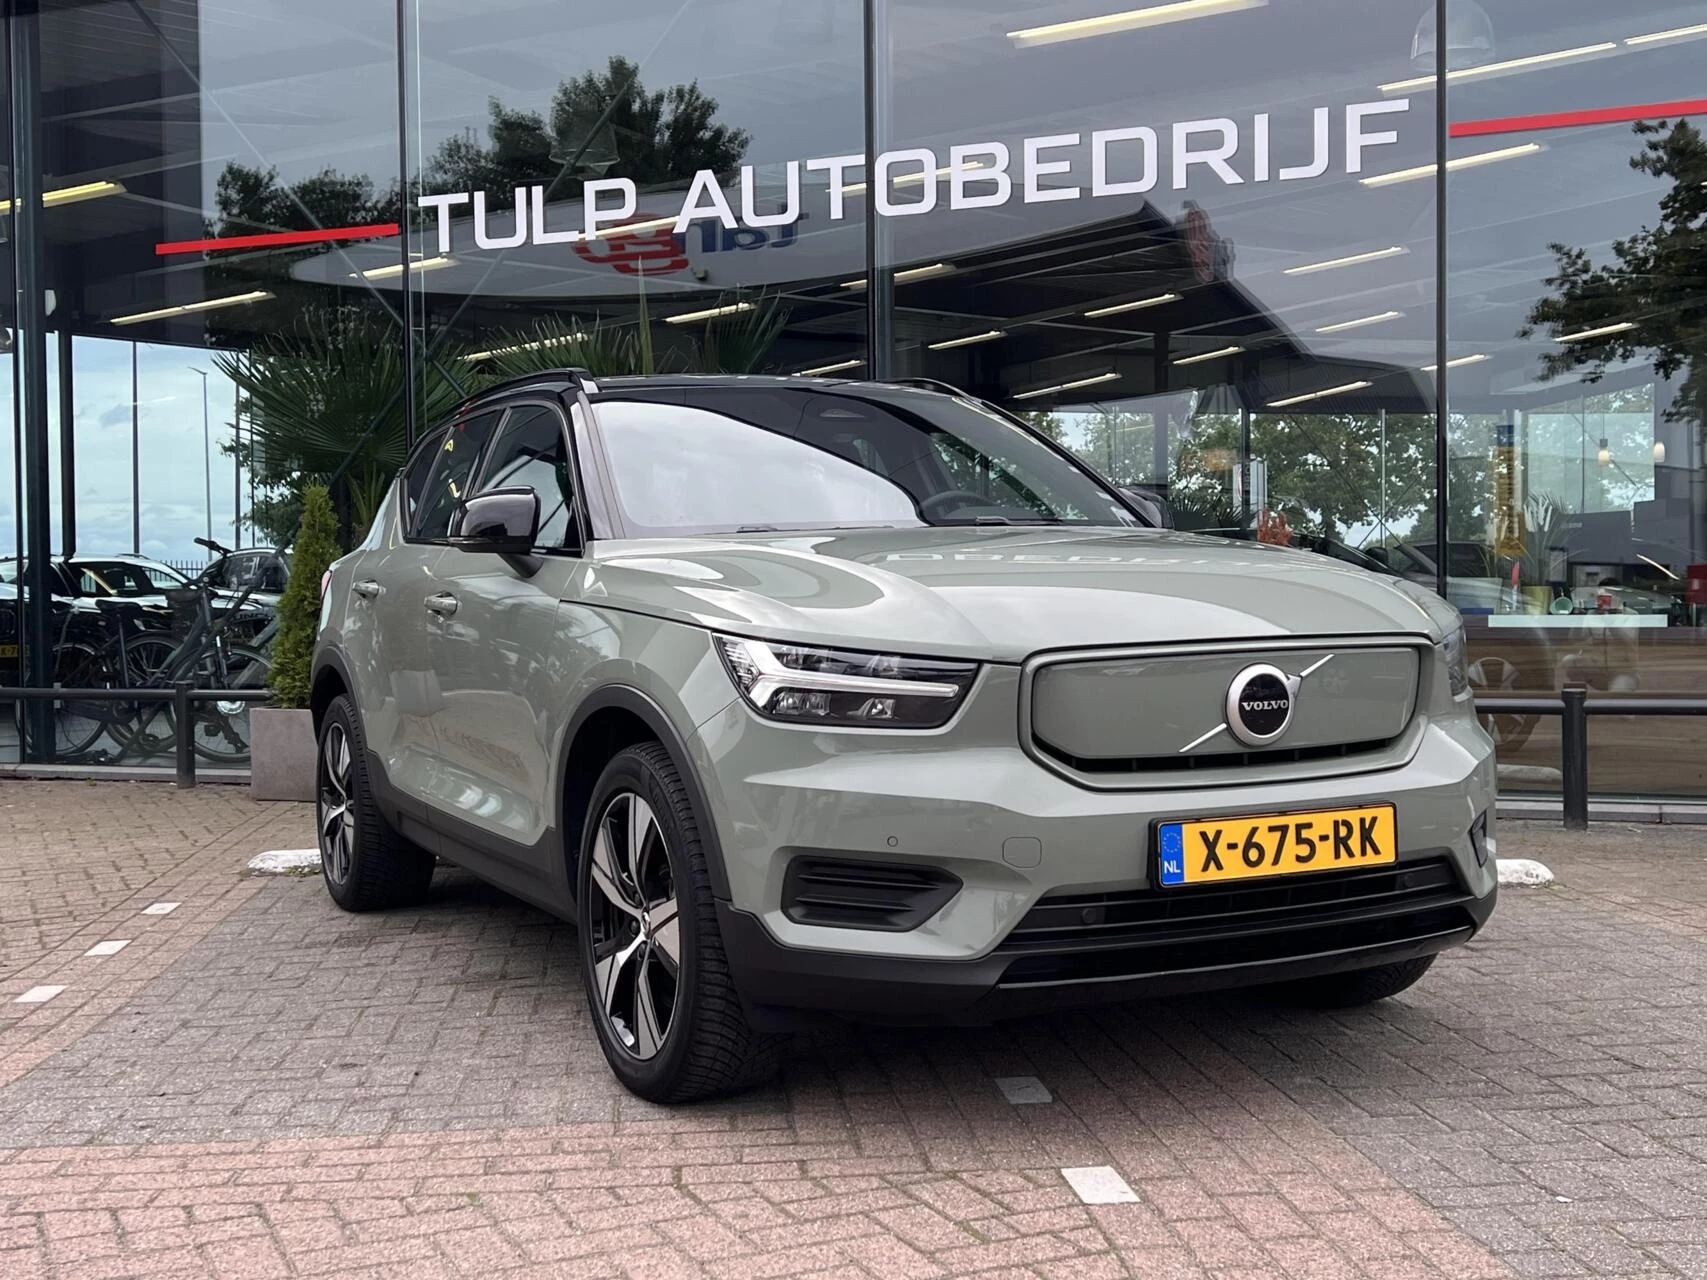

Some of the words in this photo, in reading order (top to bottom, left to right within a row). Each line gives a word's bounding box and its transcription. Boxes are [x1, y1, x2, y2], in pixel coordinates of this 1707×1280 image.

[418, 177, 637, 253] TULP
[673, 98, 1410, 234] AUTOBEDRIJF
[1241, 699, 1289, 711] VOLVO
[1199, 815, 1382, 873] X-675-RK
[1163, 860, 1181, 874] NL
